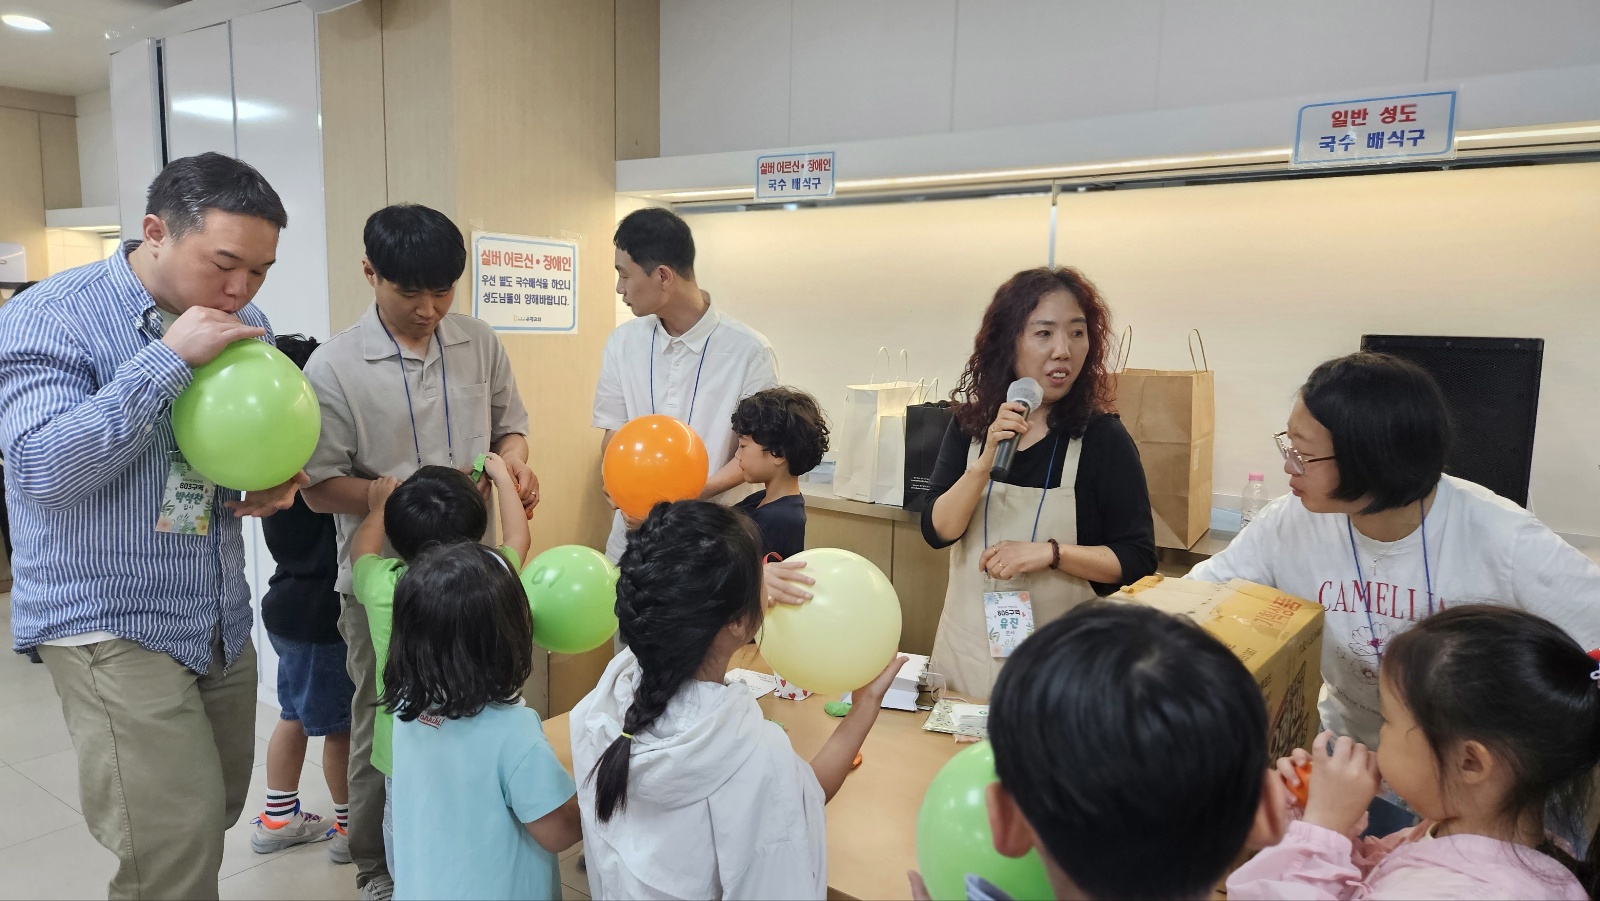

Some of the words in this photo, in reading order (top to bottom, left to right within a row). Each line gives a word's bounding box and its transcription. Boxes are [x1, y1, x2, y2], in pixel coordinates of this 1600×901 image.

[1331, 108, 1368, 128] 일반
[1379, 103, 1417, 124] 성도
[1319, 135, 1356, 152] 국수
[1366, 129, 1425, 149] 배식구
[760, 162, 775, 175] 실버
[807, 158, 831, 172] 장애인
[768, 178, 787, 191] 국수
[792, 177, 821, 190] 배식구
[481, 249, 501, 266] 실버
[543, 254, 571, 271] 장애인
[481, 275, 496, 287] 우선
[499, 275, 513, 287] 별도
[515, 276, 549, 289] 국수배식을
[551, 279, 571, 291] 하오니
[483, 292, 521, 304] 성도님들의
[1000, 617, 1019, 629] 유진
